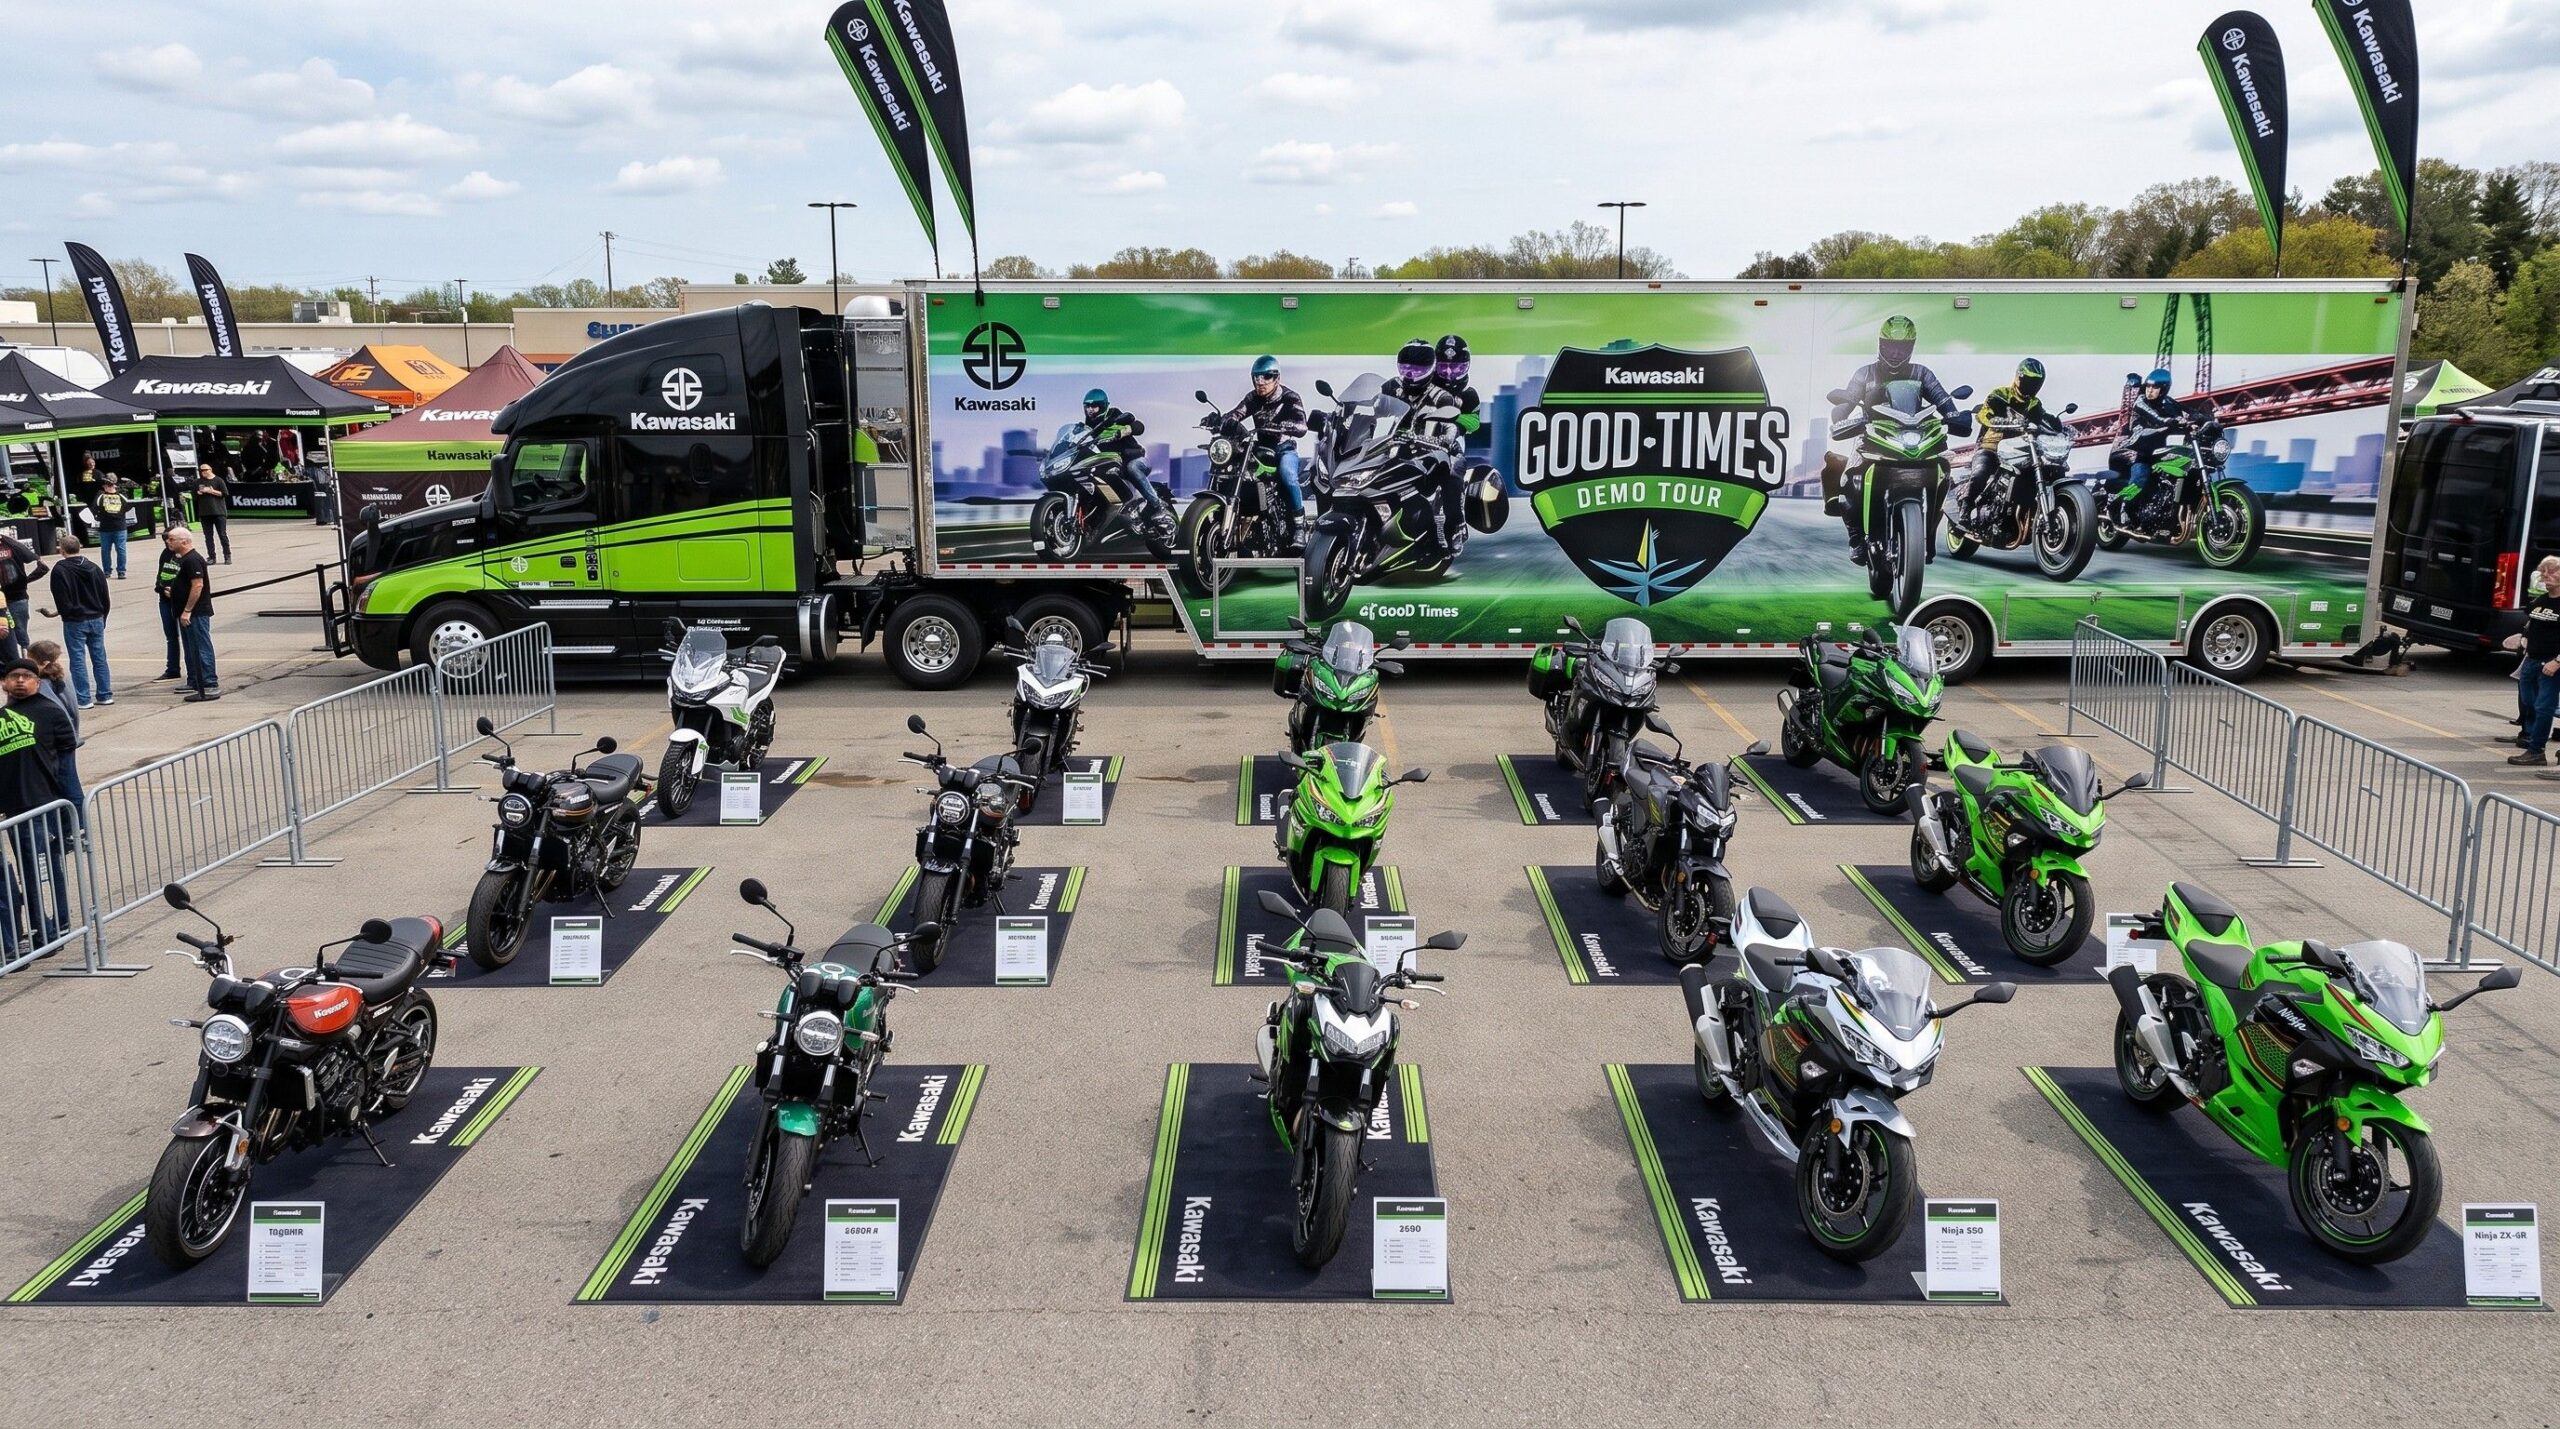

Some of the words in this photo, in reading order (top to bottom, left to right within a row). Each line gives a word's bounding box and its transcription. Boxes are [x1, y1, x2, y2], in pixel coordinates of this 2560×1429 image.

[893, 0, 947, 94] Kawasaki
[2352, 7, 2402, 104] Kawasaki
[859, 43, 911, 131] Kawasaki
[2232, 52, 2274, 138] Kawasaki
[88, 276, 127, 362] Kawasaki
[201, 283, 232, 357] Kawasaki
[132, 378, 272, 395] Kawasaki
[955, 396, 1036, 411] Kawasaki
[1604, 367, 1705, 384] Kawasaki
[419, 409, 501, 422] Kawas
[630, 412, 736, 431] Kawasaki
[232, 495, 297, 506] Kawasaki
[1577, 482, 1646, 509] DEMO
[1657, 482, 1722, 508] TOUR
[1418, 604, 1459, 617] Times
[410, 1077, 498, 1144] Kawasaki
[897, 1075, 948, 1142] Kawasaki
[1367, 1083, 1392, 1140] Kawa
[67, 1223, 146, 1288] wasaki
[629, 1199, 709, 1286] Kawasaki
[1175, 1197, 1212, 1283] Kawasaki
[1691, 1198, 1752, 1285] Kawasaki
[1941, 1227, 1964, 1236] Ninja
[2181, 1202, 2292, 1291] Kawasaki
[2475, 1232, 2498, 1240] Ninja
